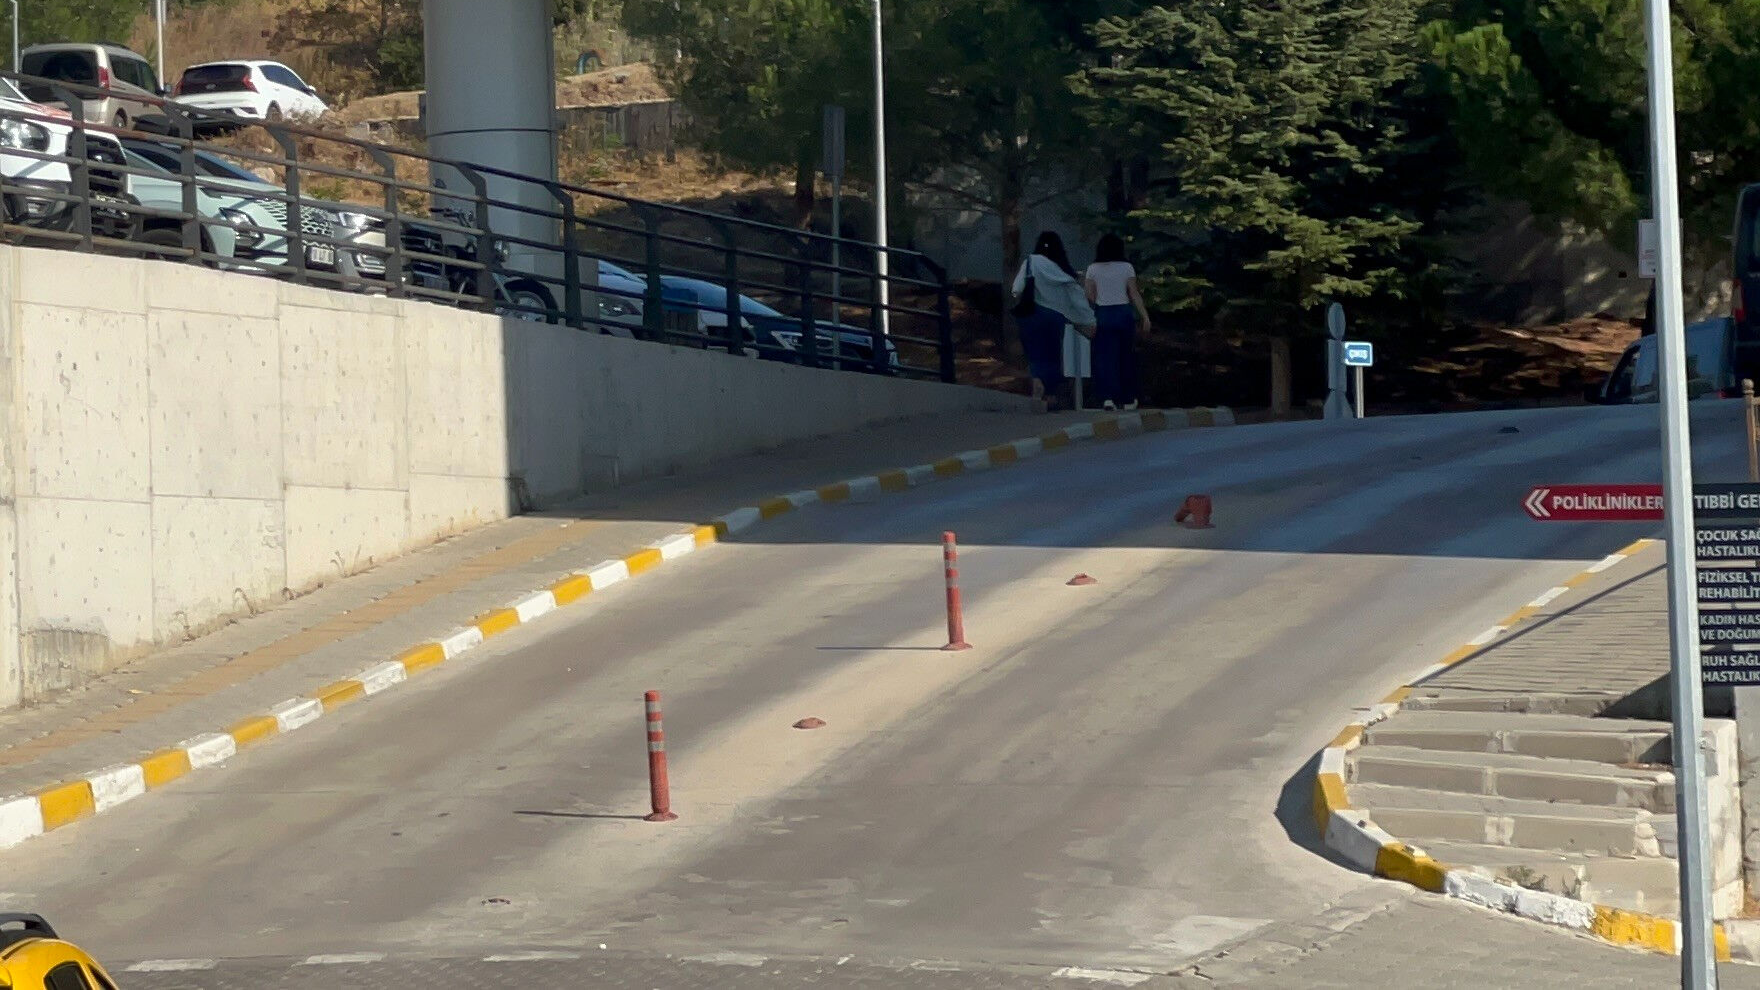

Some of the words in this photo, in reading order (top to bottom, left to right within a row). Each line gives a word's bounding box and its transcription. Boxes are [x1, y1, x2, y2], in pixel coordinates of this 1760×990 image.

[1552, 492, 1664, 510] POLİKLİNİKLER
[1695, 491, 1735, 509] TIBBİ
[1737, 494, 1760, 509] GE
[1696, 530, 1739, 544] ÇOCUK
[1700, 614, 1736, 625] KADIN
[1701, 630, 1715, 641] VE
[1702, 655, 1728, 666] RUH
